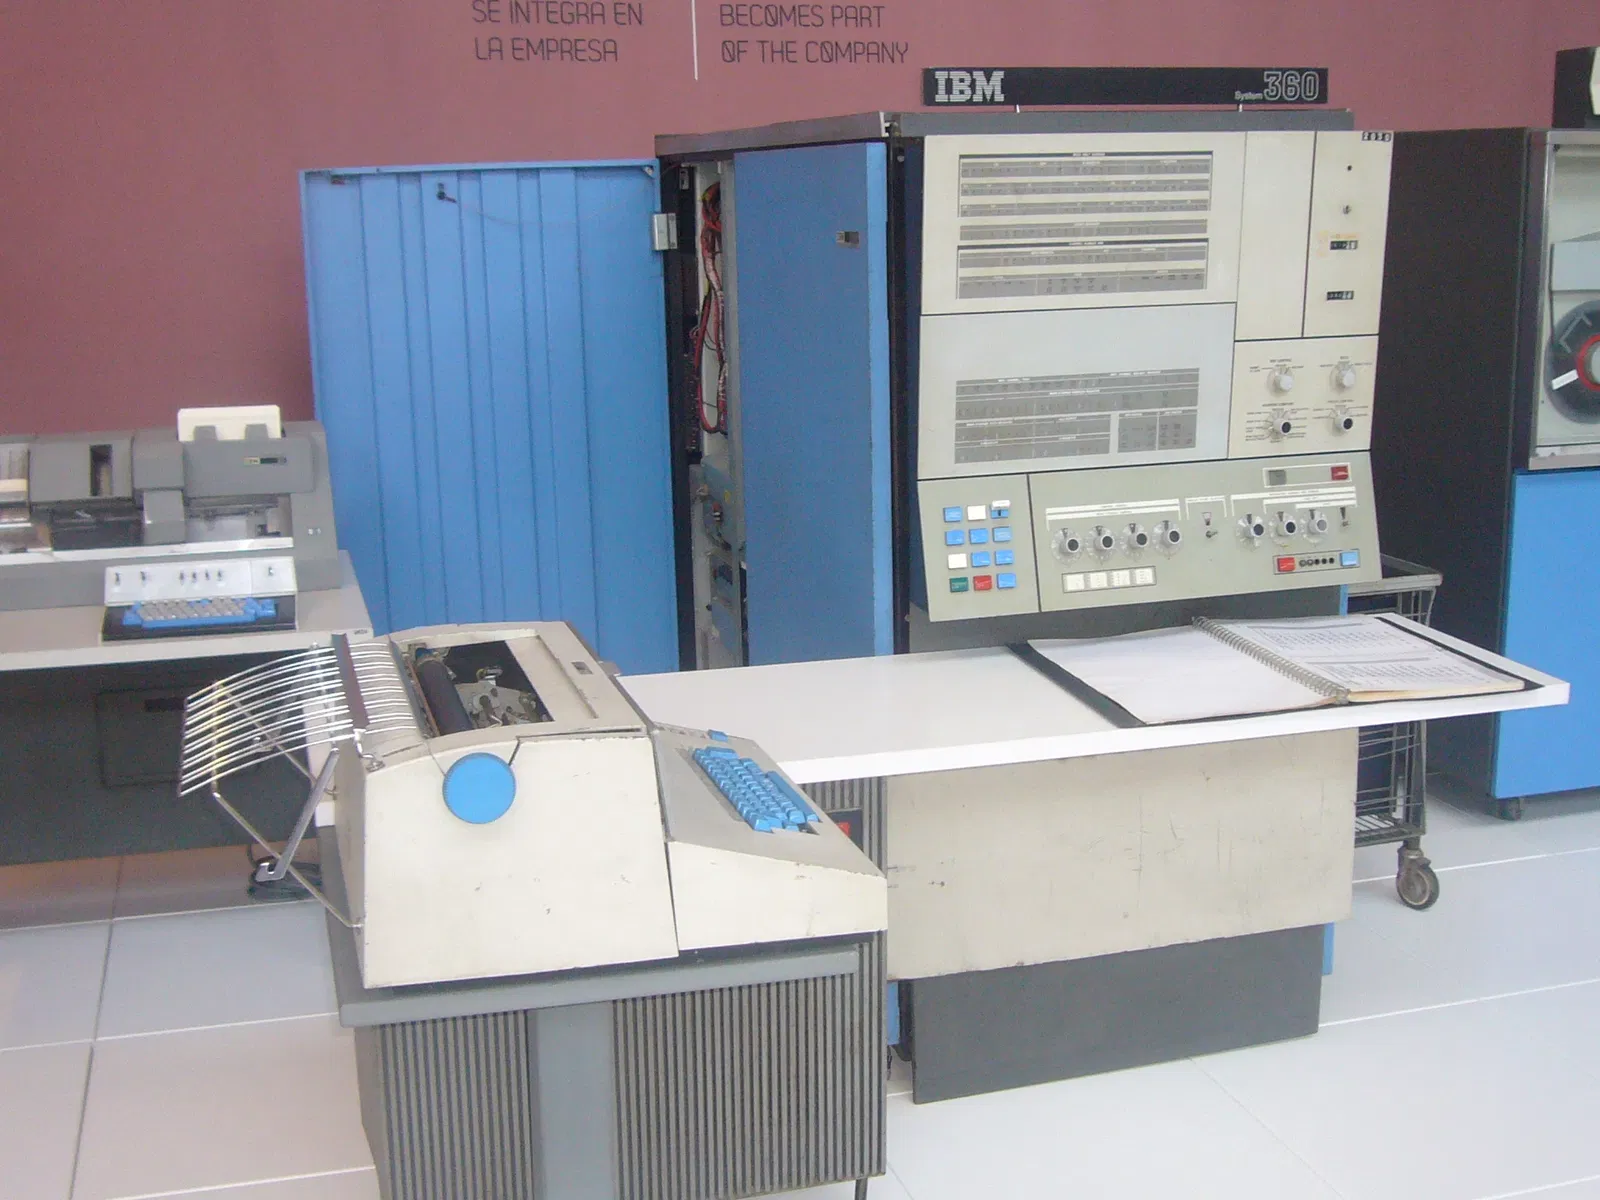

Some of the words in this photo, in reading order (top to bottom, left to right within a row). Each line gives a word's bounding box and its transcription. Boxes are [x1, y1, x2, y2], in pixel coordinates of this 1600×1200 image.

[472, 0, 501, 23] SE
[509, 0, 606, 25] INTEGRA
[613, 2, 643, 26] EN
[719, 4, 824, 28] BECOMES
[831, 5, 885, 28] PART
[474, 37, 503, 61] LA
[511, 37, 618, 62] EMPRESA
[721, 40, 749, 63] OF
[757, 40, 798, 63] THE
[805, 41, 908, 64] COMPANY
[935, 71, 1005, 102] IBM
[1234, 90, 1264, 101] System
[1263, 70, 1320, 101] 360
